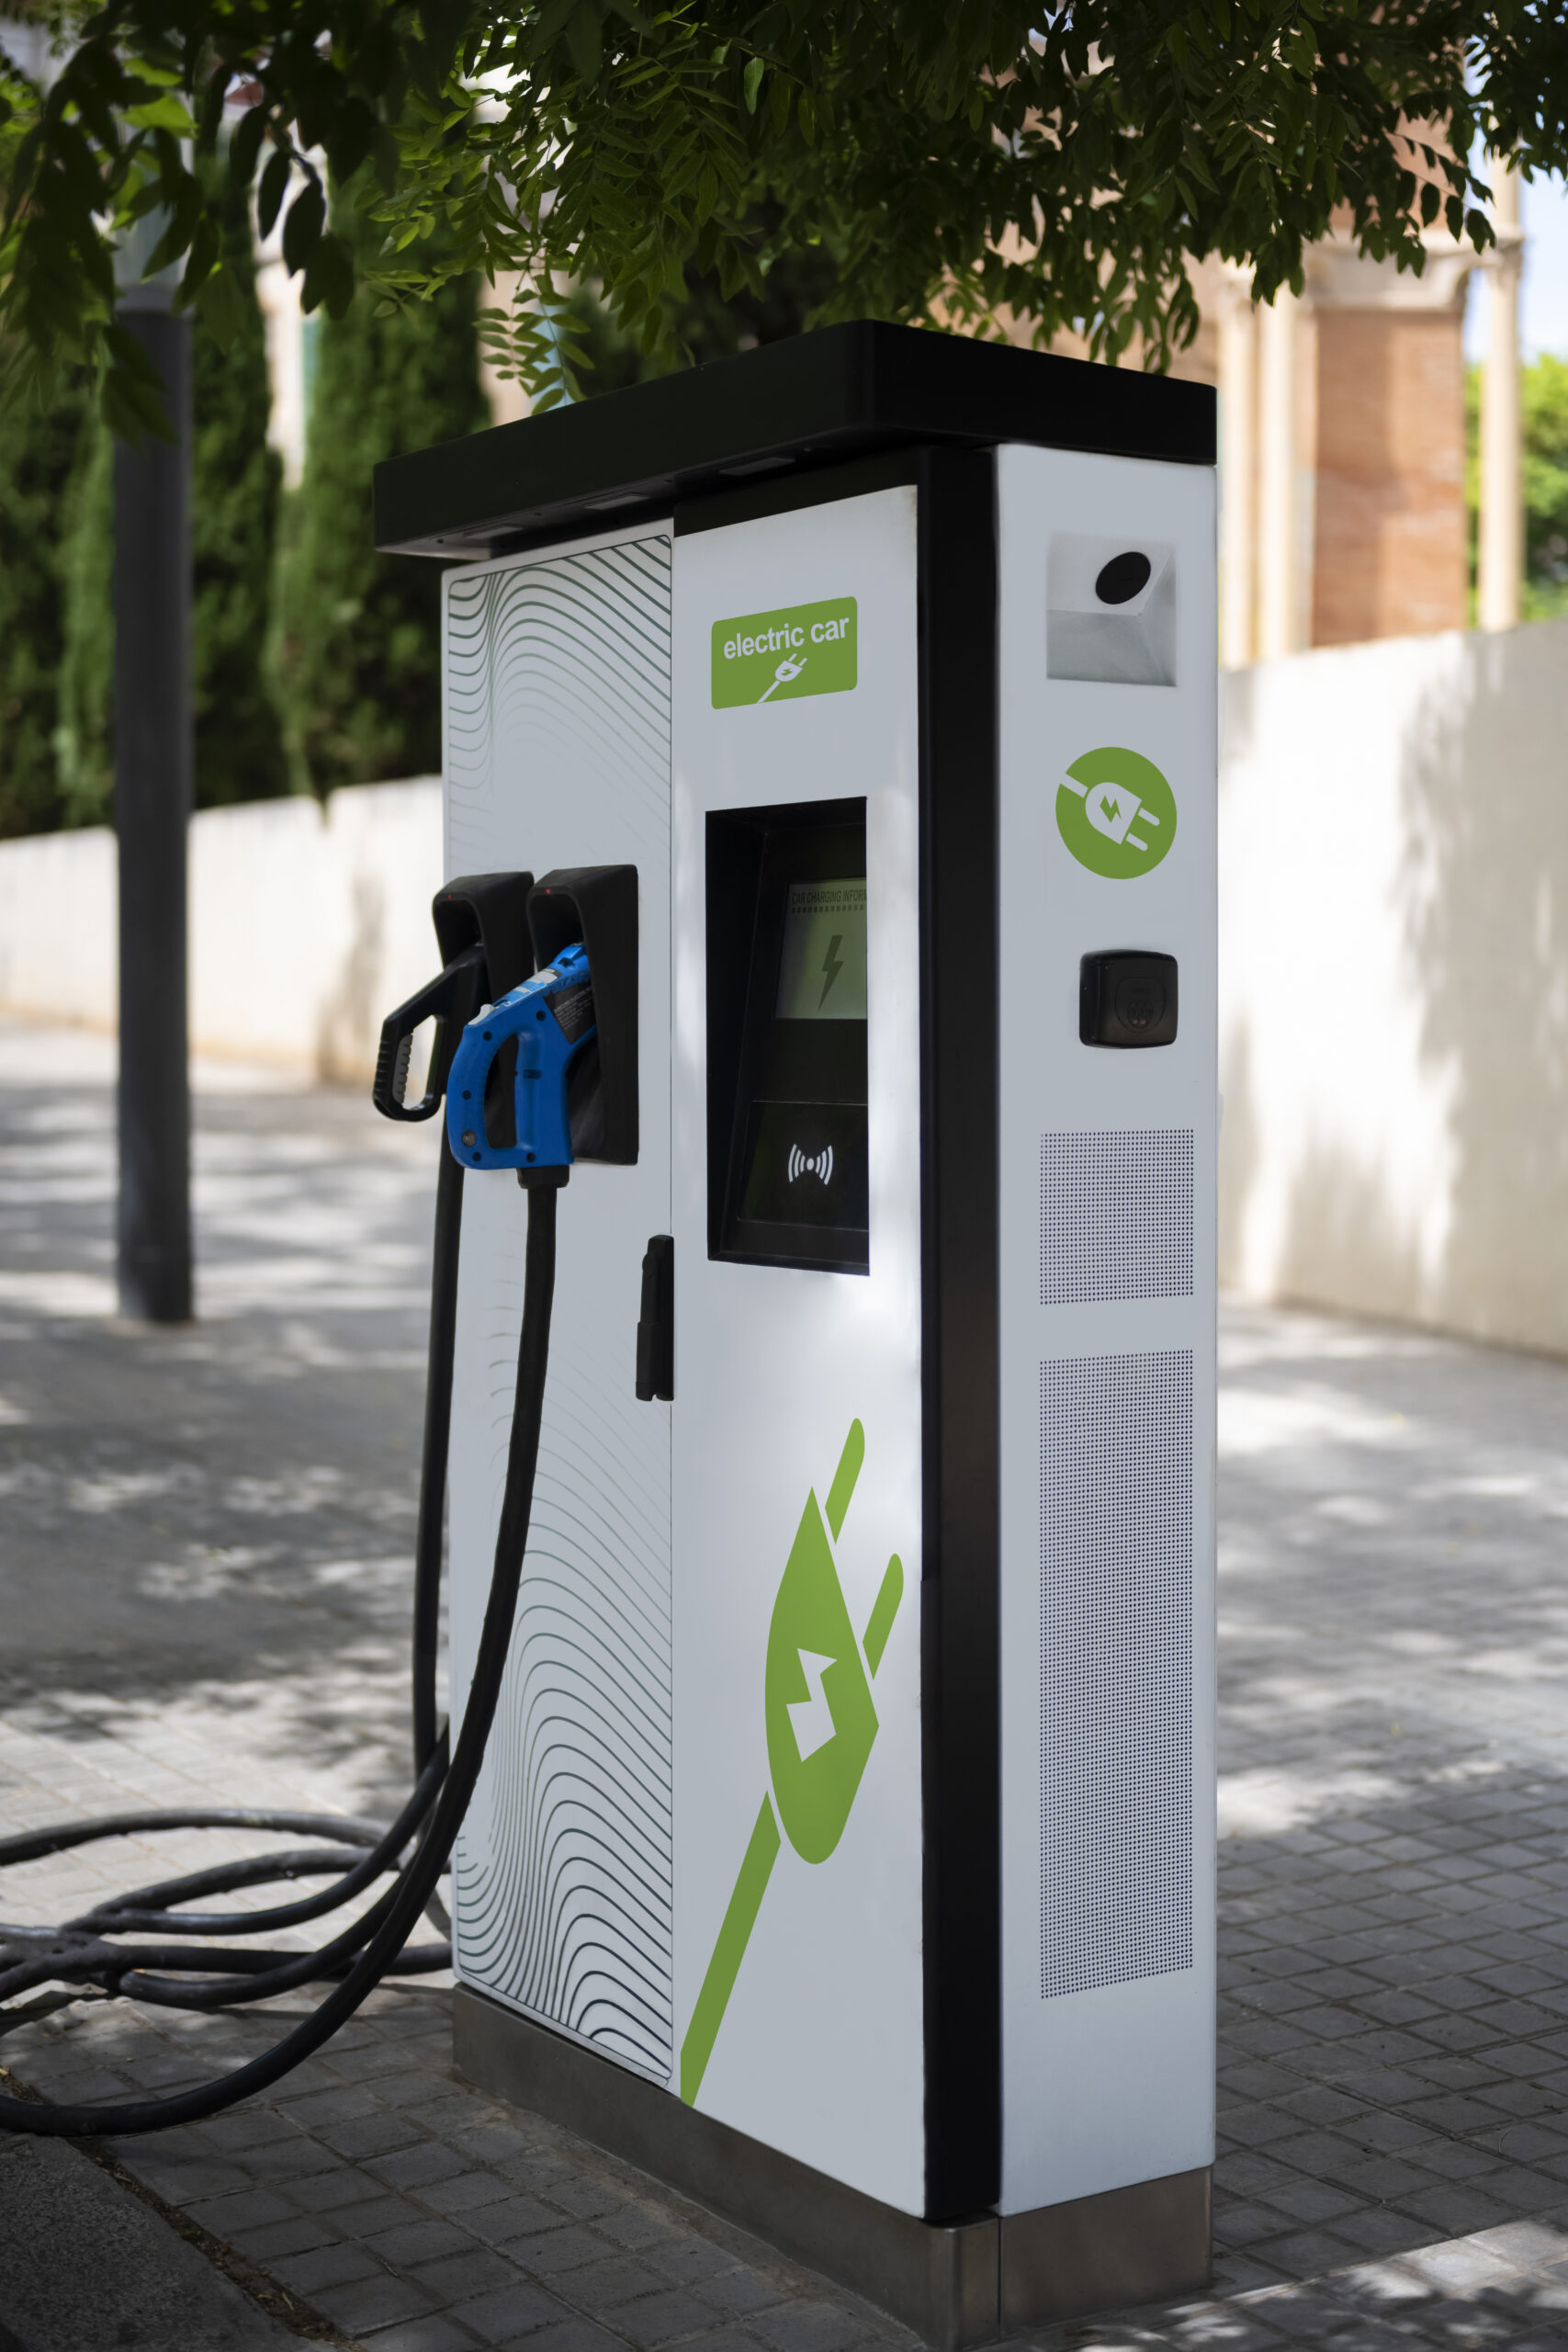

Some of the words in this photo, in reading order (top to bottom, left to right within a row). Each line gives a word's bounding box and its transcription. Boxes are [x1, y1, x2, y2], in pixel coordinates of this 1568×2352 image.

[723, 622, 806, 660] electric
[810, 616, 850, 643] car
[792, 892, 806, 905] CAR
[807, 890, 841, 904] CHARGING
